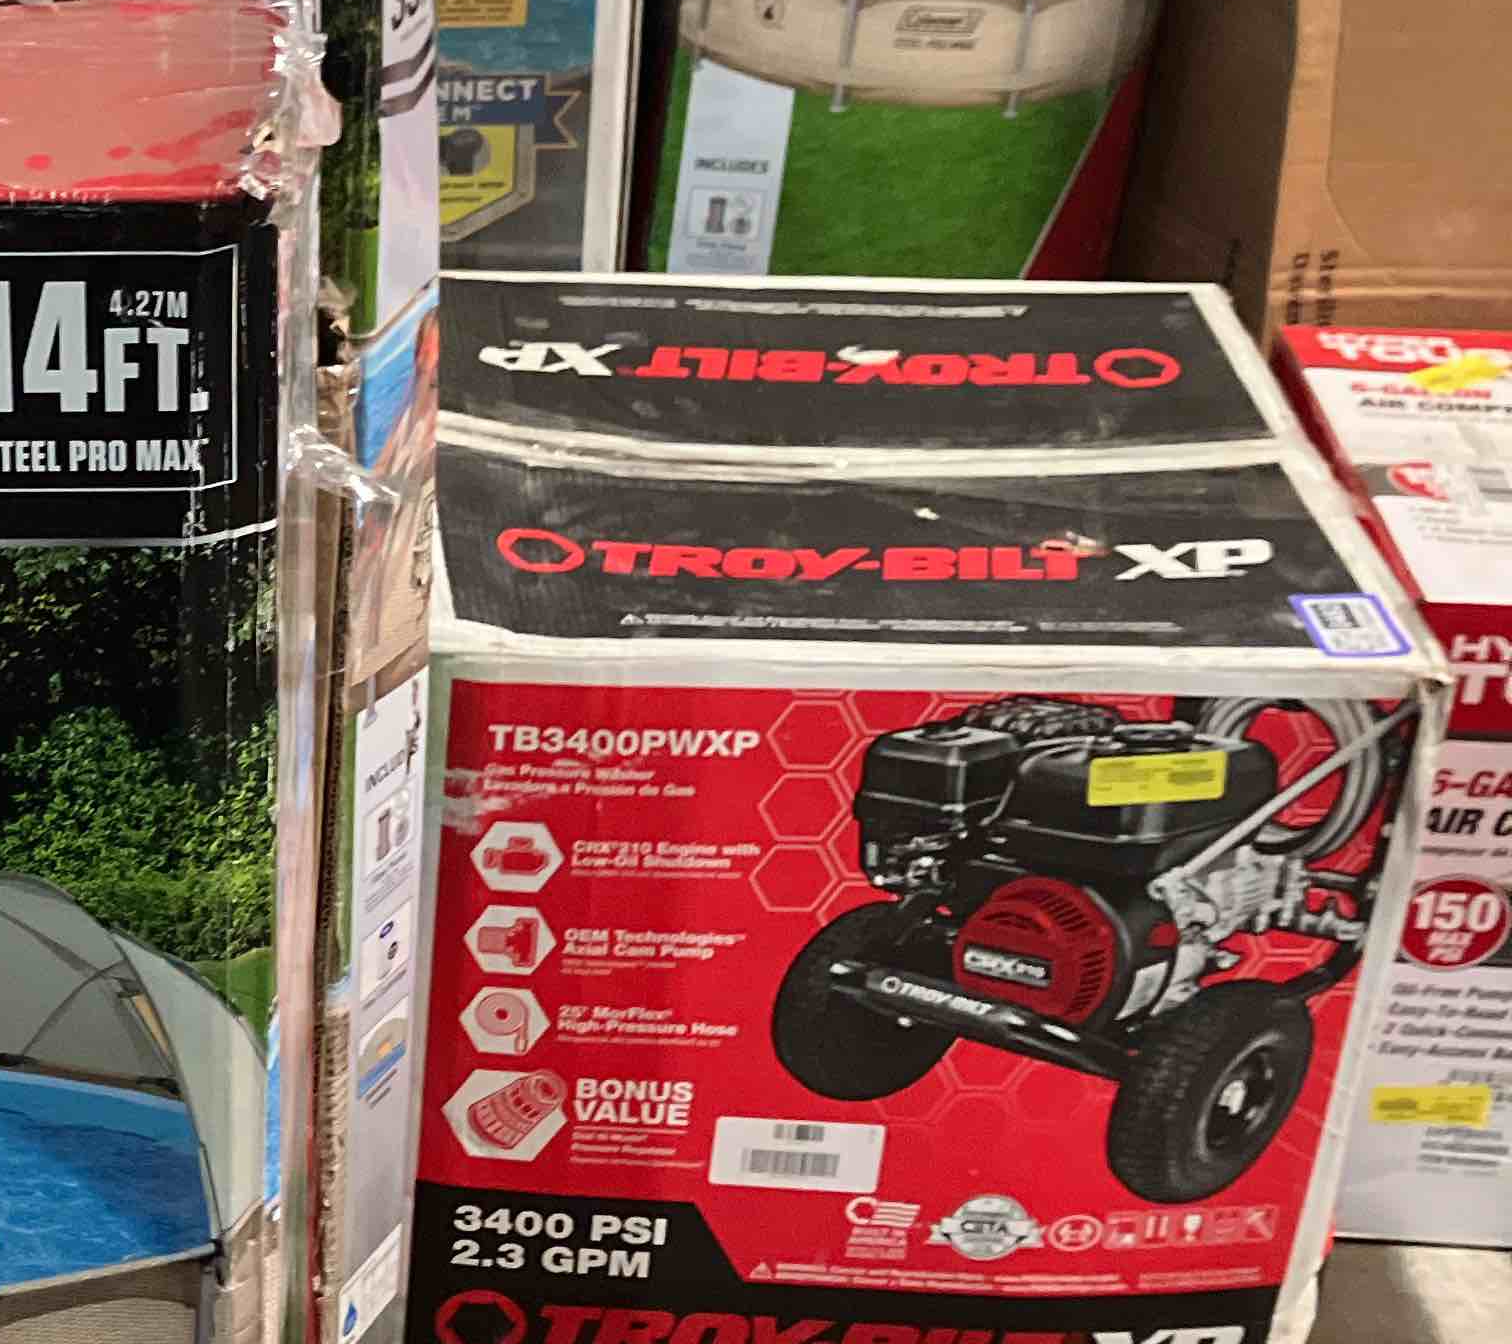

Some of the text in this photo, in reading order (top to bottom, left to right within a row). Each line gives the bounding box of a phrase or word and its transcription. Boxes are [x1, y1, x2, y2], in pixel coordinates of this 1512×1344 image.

[108, 289, 188, 319] 4.27M
[103, 327, 210, 414] FT.
[478, 340, 1102, 388] TROY-BILT XP
[69, 439, 128, 473] PRO
[590, 538, 1275, 584] TROY-BILT XP
[487, 723, 761, 758] TB3400PWXP
[656, 841, 719, 858] Engine
[721, 843, 761, 856] with
[1413, 892, 1501, 932] 150
[659, 944, 716, 961] Pump
[690, 1021, 739, 1037] Hose
[575, 1077, 695, 1103] BONUS
[572, 1099, 691, 1126] VALUE
[452, 1204, 669, 1246] 3400 PSI
[448, 1239, 651, 1278] 2.3 GPM
